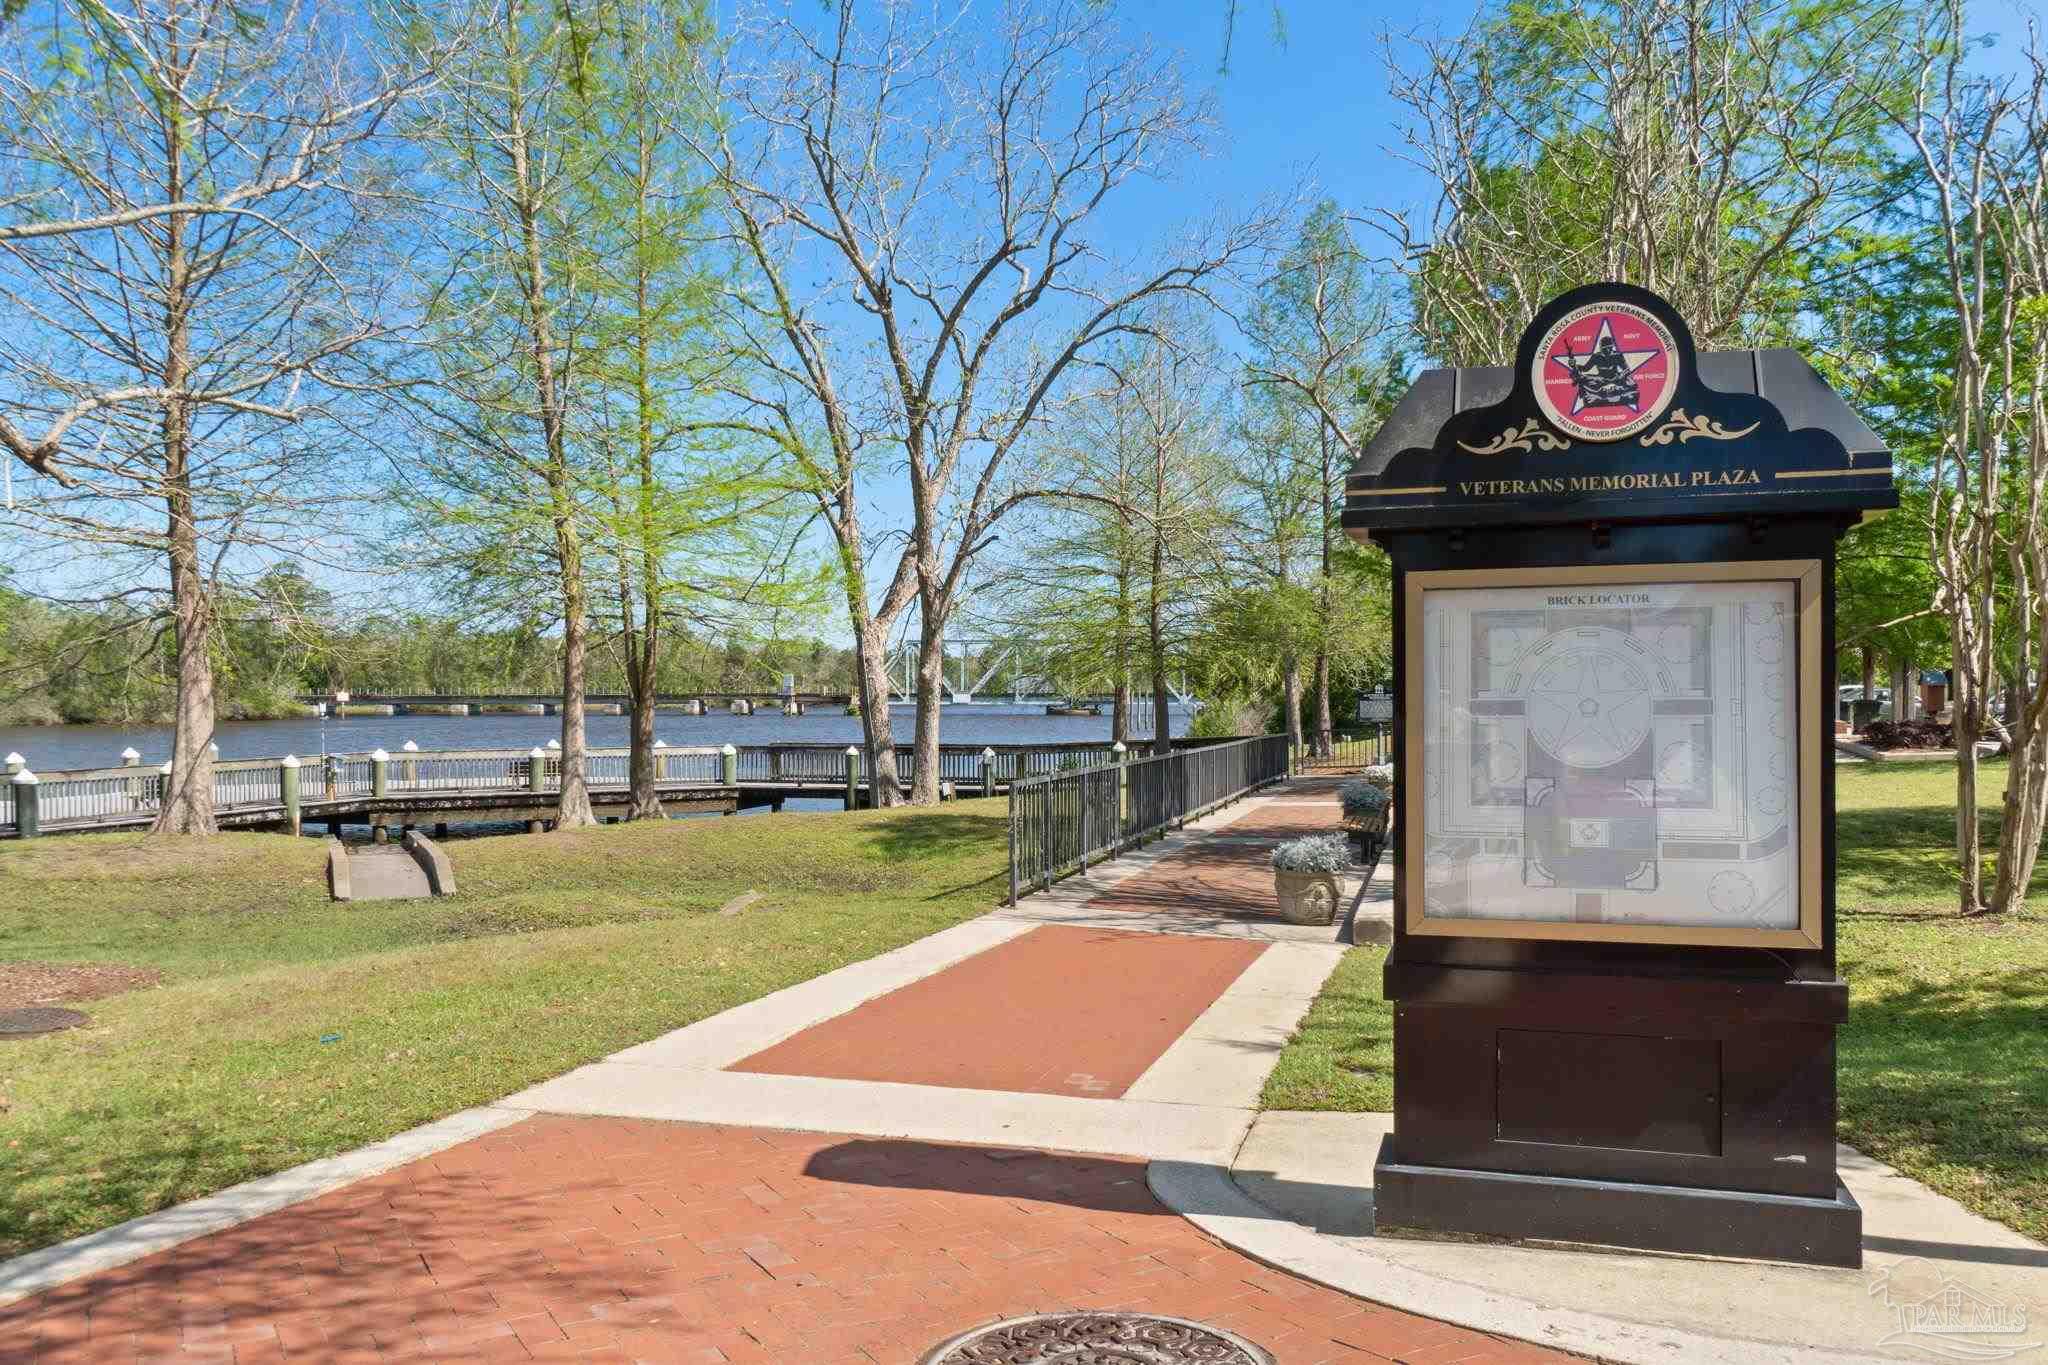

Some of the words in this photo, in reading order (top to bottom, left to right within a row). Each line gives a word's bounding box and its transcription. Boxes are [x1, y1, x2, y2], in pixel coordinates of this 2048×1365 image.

[1537, 336, 1554, 360] SANTA
[1552, 319, 1571, 336] ROSA
[1570, 305, 1604, 320] COUNTY
[1605, 304, 1646, 320] VETERANS
[1647, 317, 1674, 352] MEMORIAL
[1459, 478, 1565, 496] VETERANS
[1568, 472, 1687, 491] MEMORIAL
[1690, 469, 1761, 487] PLAZA
[1547, 595, 1586, 606] BRICK
[1589, 592, 1650, 604] LOCATOR
